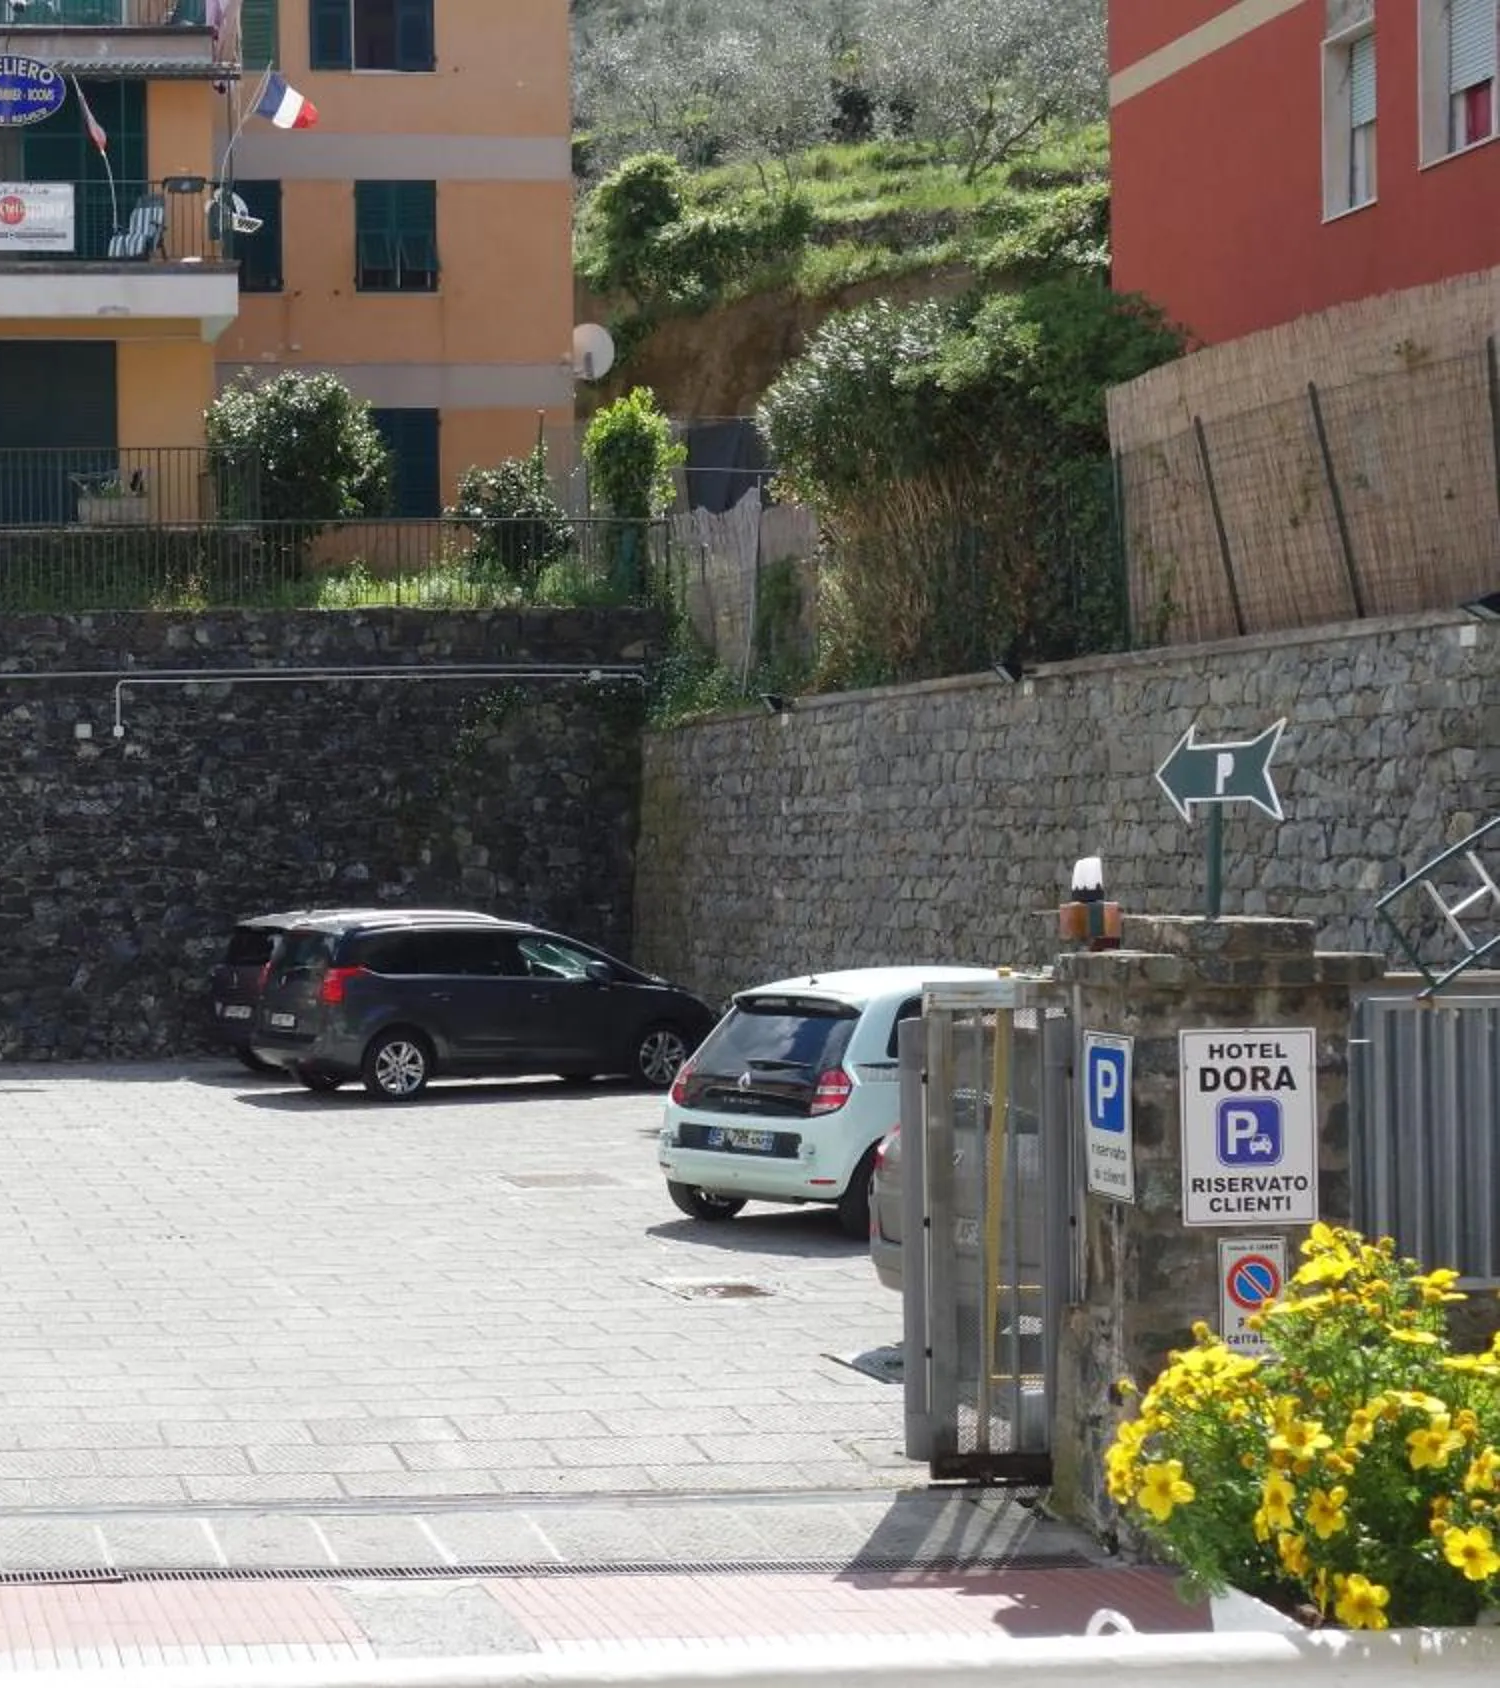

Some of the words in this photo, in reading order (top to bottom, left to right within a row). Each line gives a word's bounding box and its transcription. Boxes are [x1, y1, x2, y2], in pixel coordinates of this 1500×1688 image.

[1216, 753, 1235, 794] P
[1208, 1042, 1288, 1060] HOTEL
[1096, 1059, 1118, 1119] P
[1199, 1066, 1297, 1092] DORA
[1227, 1111, 1259, 1155] P
[1191, 1176, 1308, 1193] RISERVATO
[1209, 1196, 1291, 1212] CLIENTI
